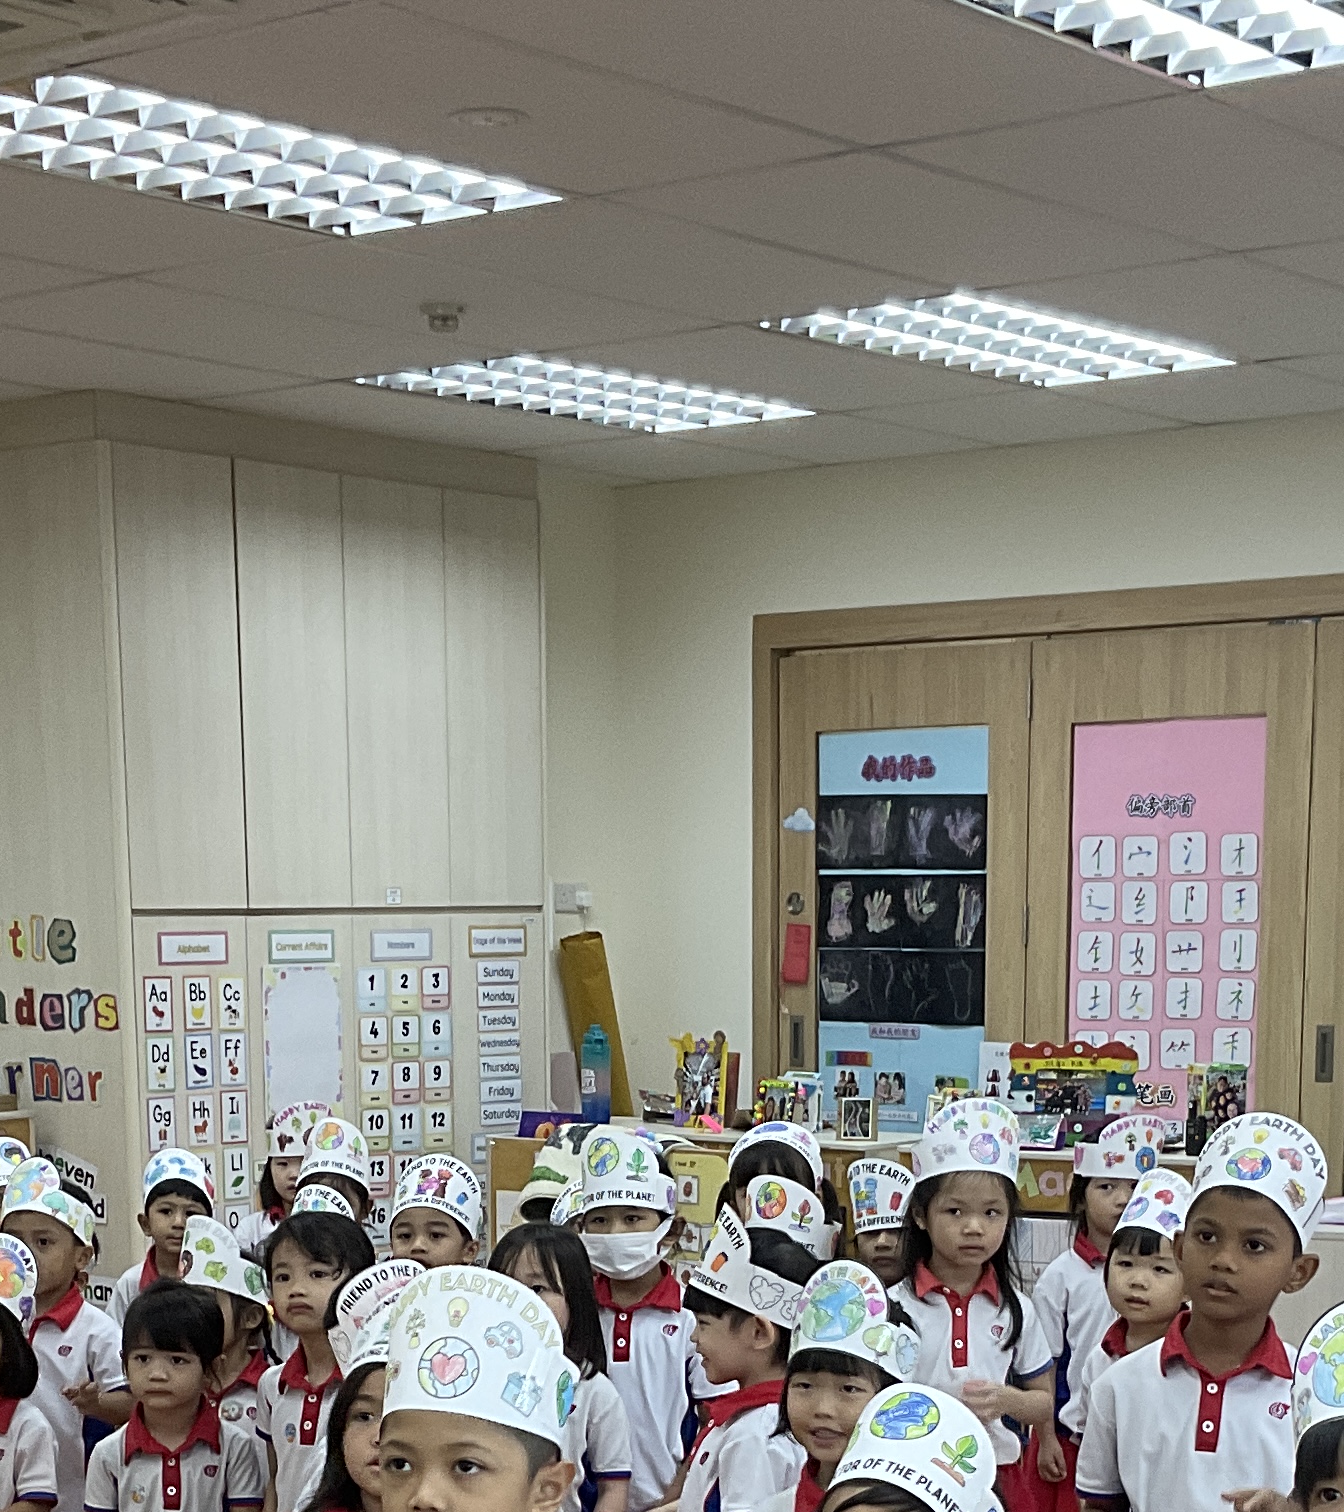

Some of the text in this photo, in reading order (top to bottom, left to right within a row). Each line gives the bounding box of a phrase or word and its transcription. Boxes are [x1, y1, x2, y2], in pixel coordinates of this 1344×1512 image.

[400, 974, 409, 989] 2
[432, 973, 440, 989] 3
[483, 966, 515, 980] Sunday
[368, 974, 375, 991] 1
[149, 983, 168, 1003] Aa
[189, 983, 207, 1002] Bb
[223, 983, 241, 1001] Cc
[482, 990, 515, 1003] Monday
[369, 1021, 379, 1039] 4
[401, 1021, 410, 1037] 5
[432, 1019, 441, 1035] 6
[482, 1015, 516, 1028] Tuesday
[190, 1041, 207, 1060] Ee
[224, 1039, 241, 1058] Ff
[479, 1038, 521, 1050] Wednesday
[151, 1044, 170, 1064] Dd
[402, 1066, 411, 1082] 8
[433, 1066, 442, 1081] 9
[482, 1062, 520, 1075] Thursday
[371, 1070, 379, 1086] 7
[488, 1085, 515, 1098] Friday
[1135, 1082, 1176, 1107] 笔画
[153, 1105, 171, 1127] Gg
[192, 1101, 210, 1119] Hh
[483, 1108, 521, 1122] Saturday
[368, 1114, 384, 1130] 10
[400, 1113, 413, 1129] 11
[431, 1112, 446, 1127] 12
[1249, 1115, 1302, 1142] EARTH
[1303, 1136, 1326, 1181] DAY
[370, 1160, 384, 1177] 13
[438, 1156, 457, 1170] THE
[456, 1164, 479, 1196] EARTH
[862, 1163, 911, 1186] THE EARTH
[314, 1188, 331, 1199] THE
[595, 1190, 656, 1203] OF THE PLANET
[371, 1205, 386, 1225] 16
[722, 1217, 745, 1251] EARTH
[340, 1264, 411, 1315] FRIEND TO THE
[439, 1272, 561, 1349] EARTH DAY
[863, 1457, 884, 1470] OF
[885, 1460, 913, 1481] THE
